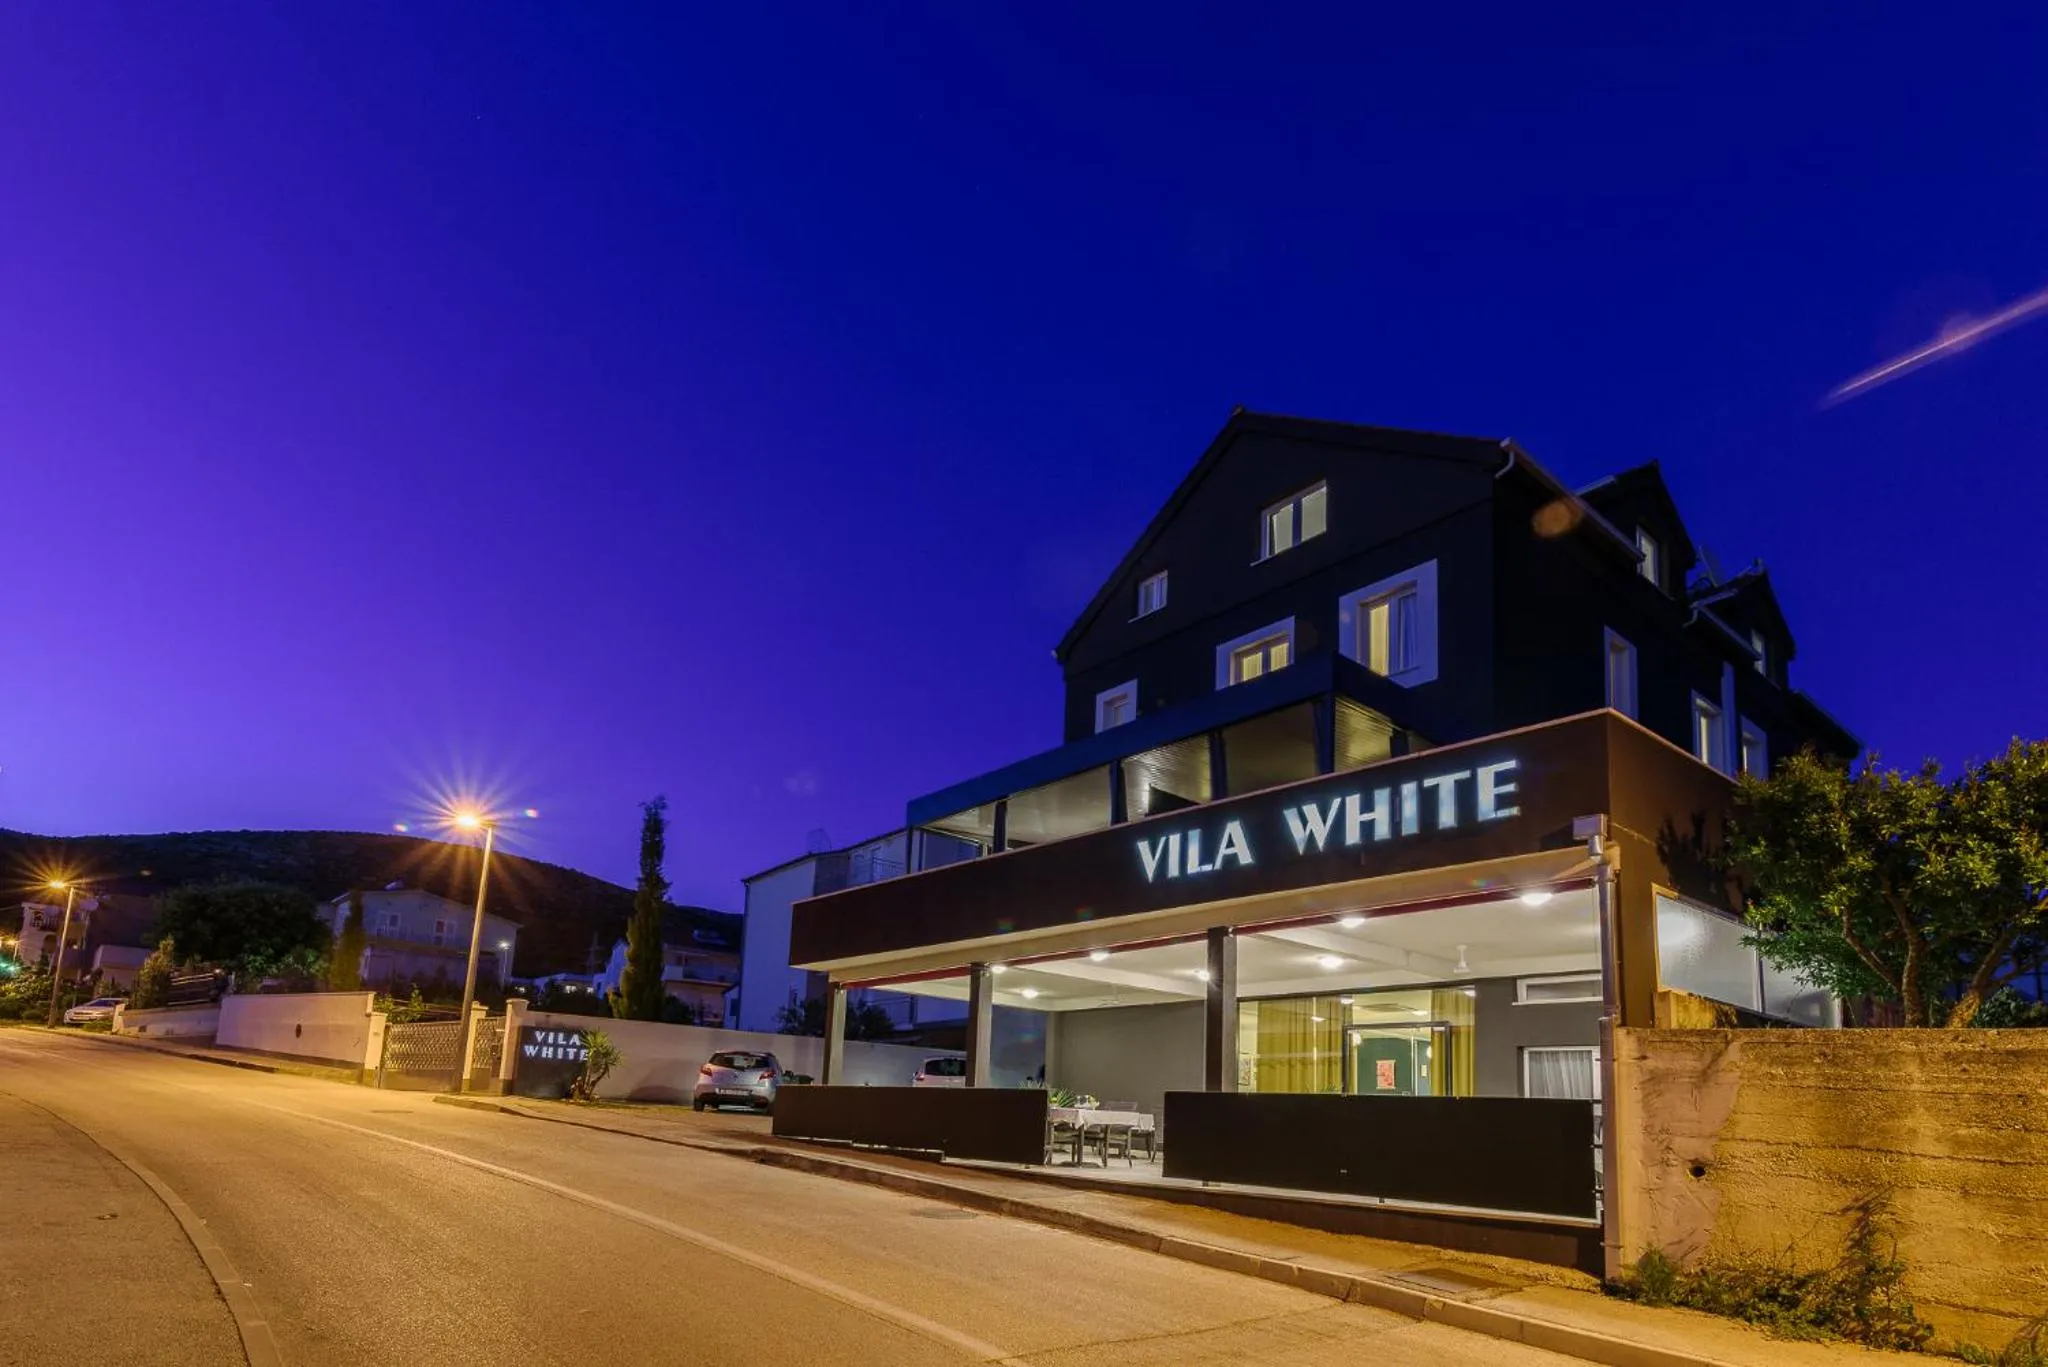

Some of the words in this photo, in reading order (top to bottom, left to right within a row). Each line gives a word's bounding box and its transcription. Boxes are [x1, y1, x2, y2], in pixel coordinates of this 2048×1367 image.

[1137, 820, 1253, 883] VILA
[1283, 760, 1521, 855] WHITE
[534, 1031, 581, 1046] VILA
[524, 1045, 589, 1061] WHITE
